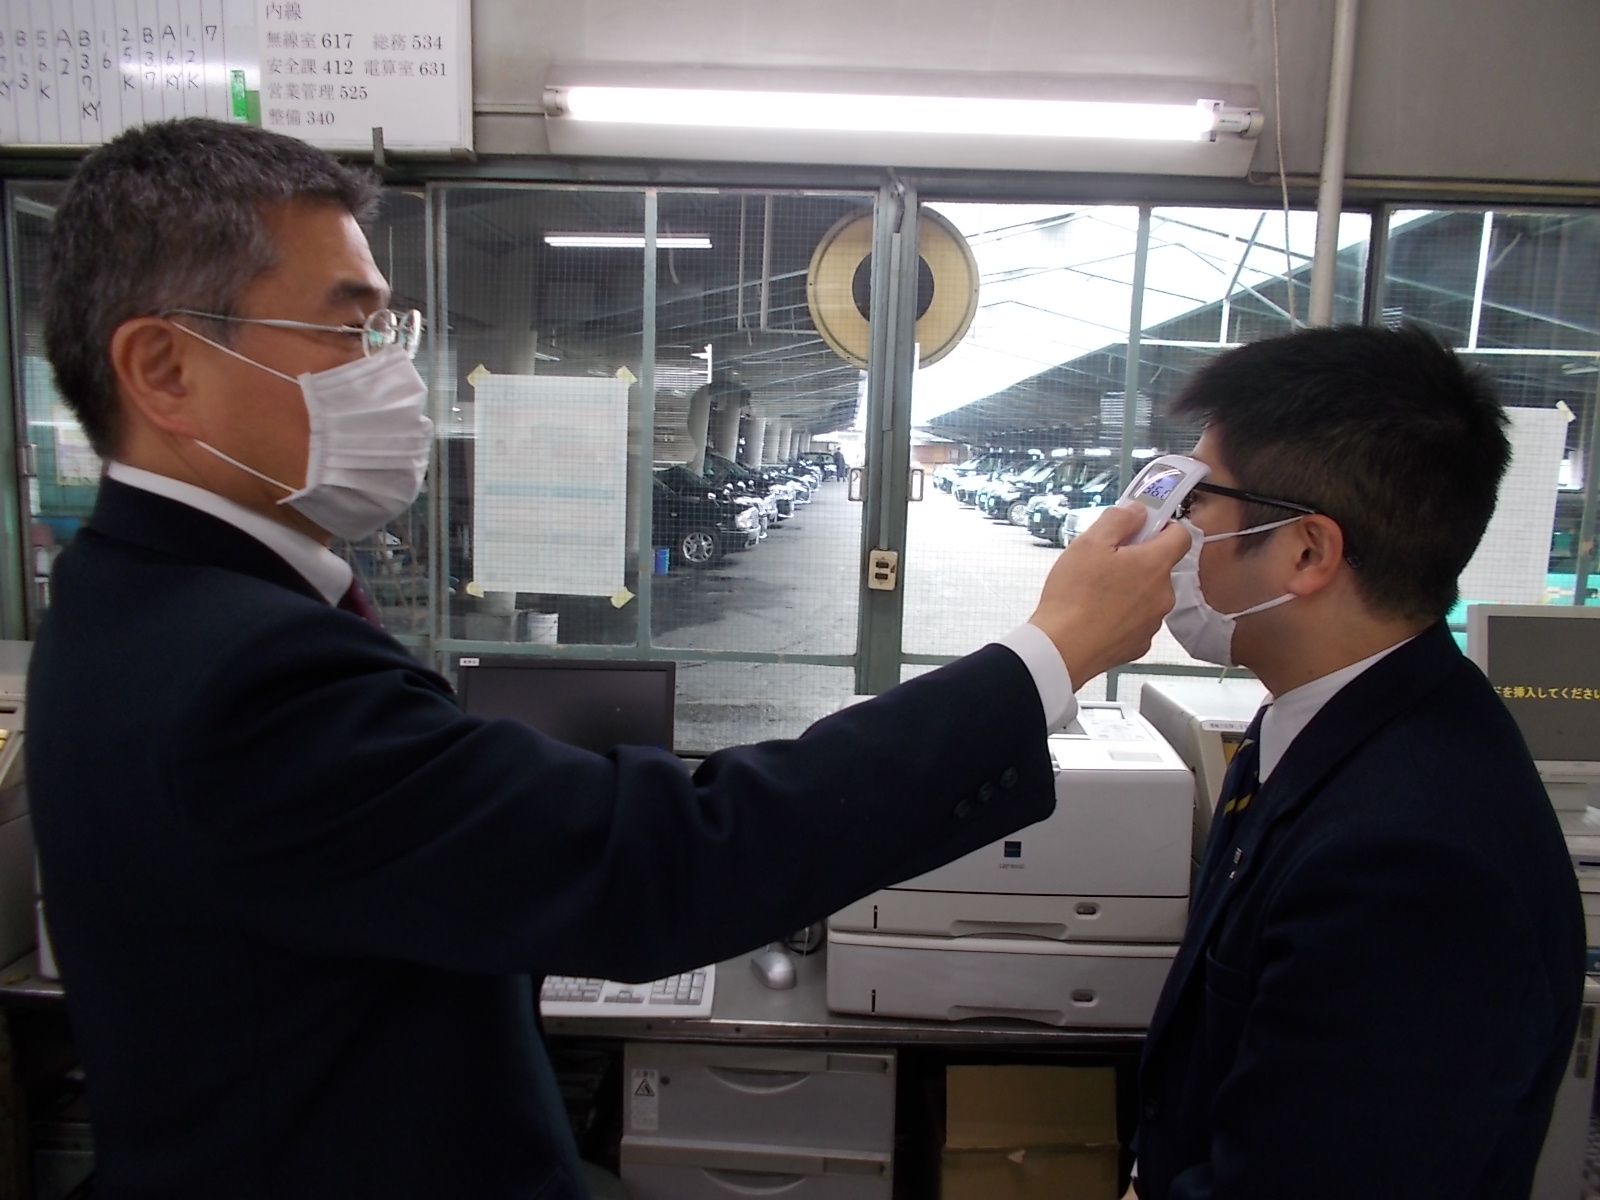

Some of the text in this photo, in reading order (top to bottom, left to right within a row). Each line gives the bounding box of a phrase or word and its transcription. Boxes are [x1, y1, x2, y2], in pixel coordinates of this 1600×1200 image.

[265, 2, 302, 20] 内線
[267, 31, 442, 51] 無線室 617 総務 534
[267, 57, 447, 77] 安全課 412 電算室 631
[267, 82, 368, 100] 営業管理 525
[268, 107, 335, 126] 整備 340
